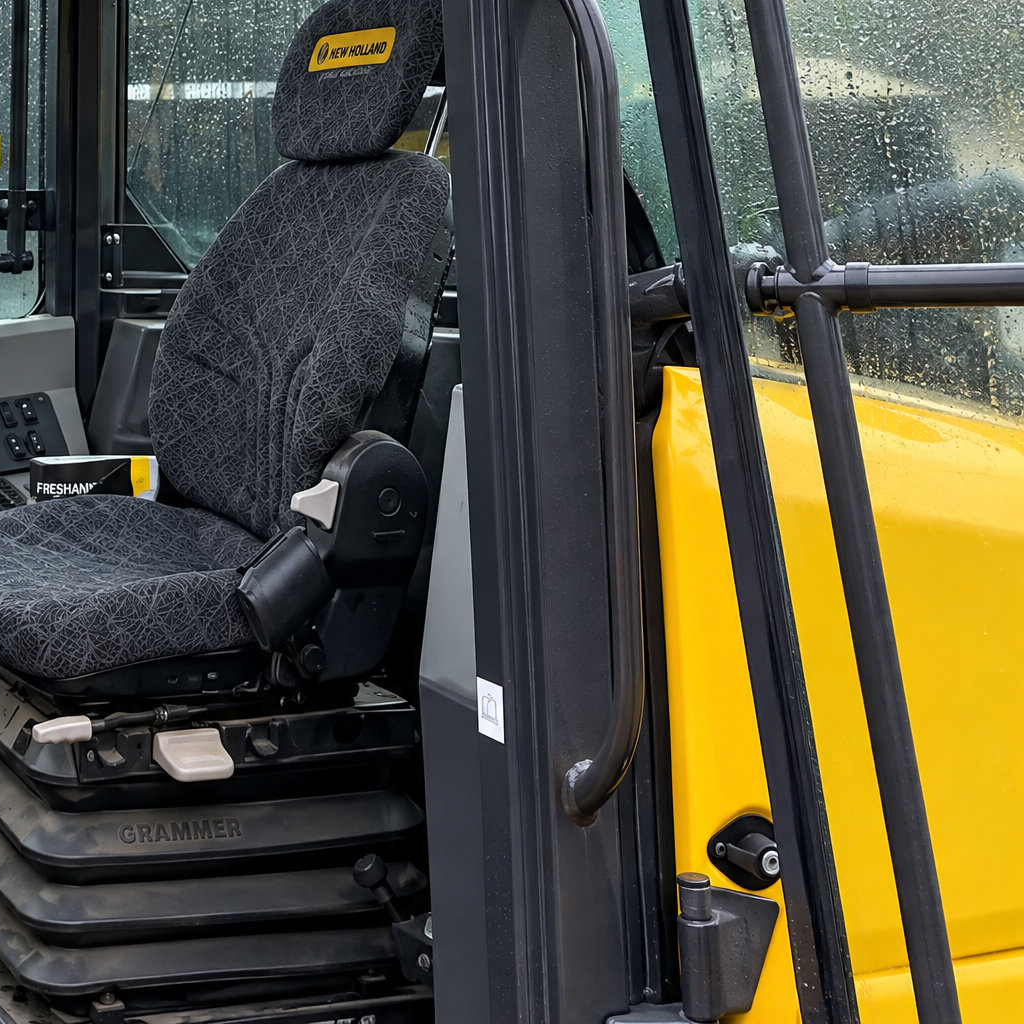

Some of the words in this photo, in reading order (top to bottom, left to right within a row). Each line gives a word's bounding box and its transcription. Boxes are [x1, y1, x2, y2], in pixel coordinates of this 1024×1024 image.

[329, 46, 349, 59] NEW
[348, 41, 387, 57] HOLLAND
[36, 481, 97, 495] FRESHAN
[118, 818, 243, 844] GRAMMER
